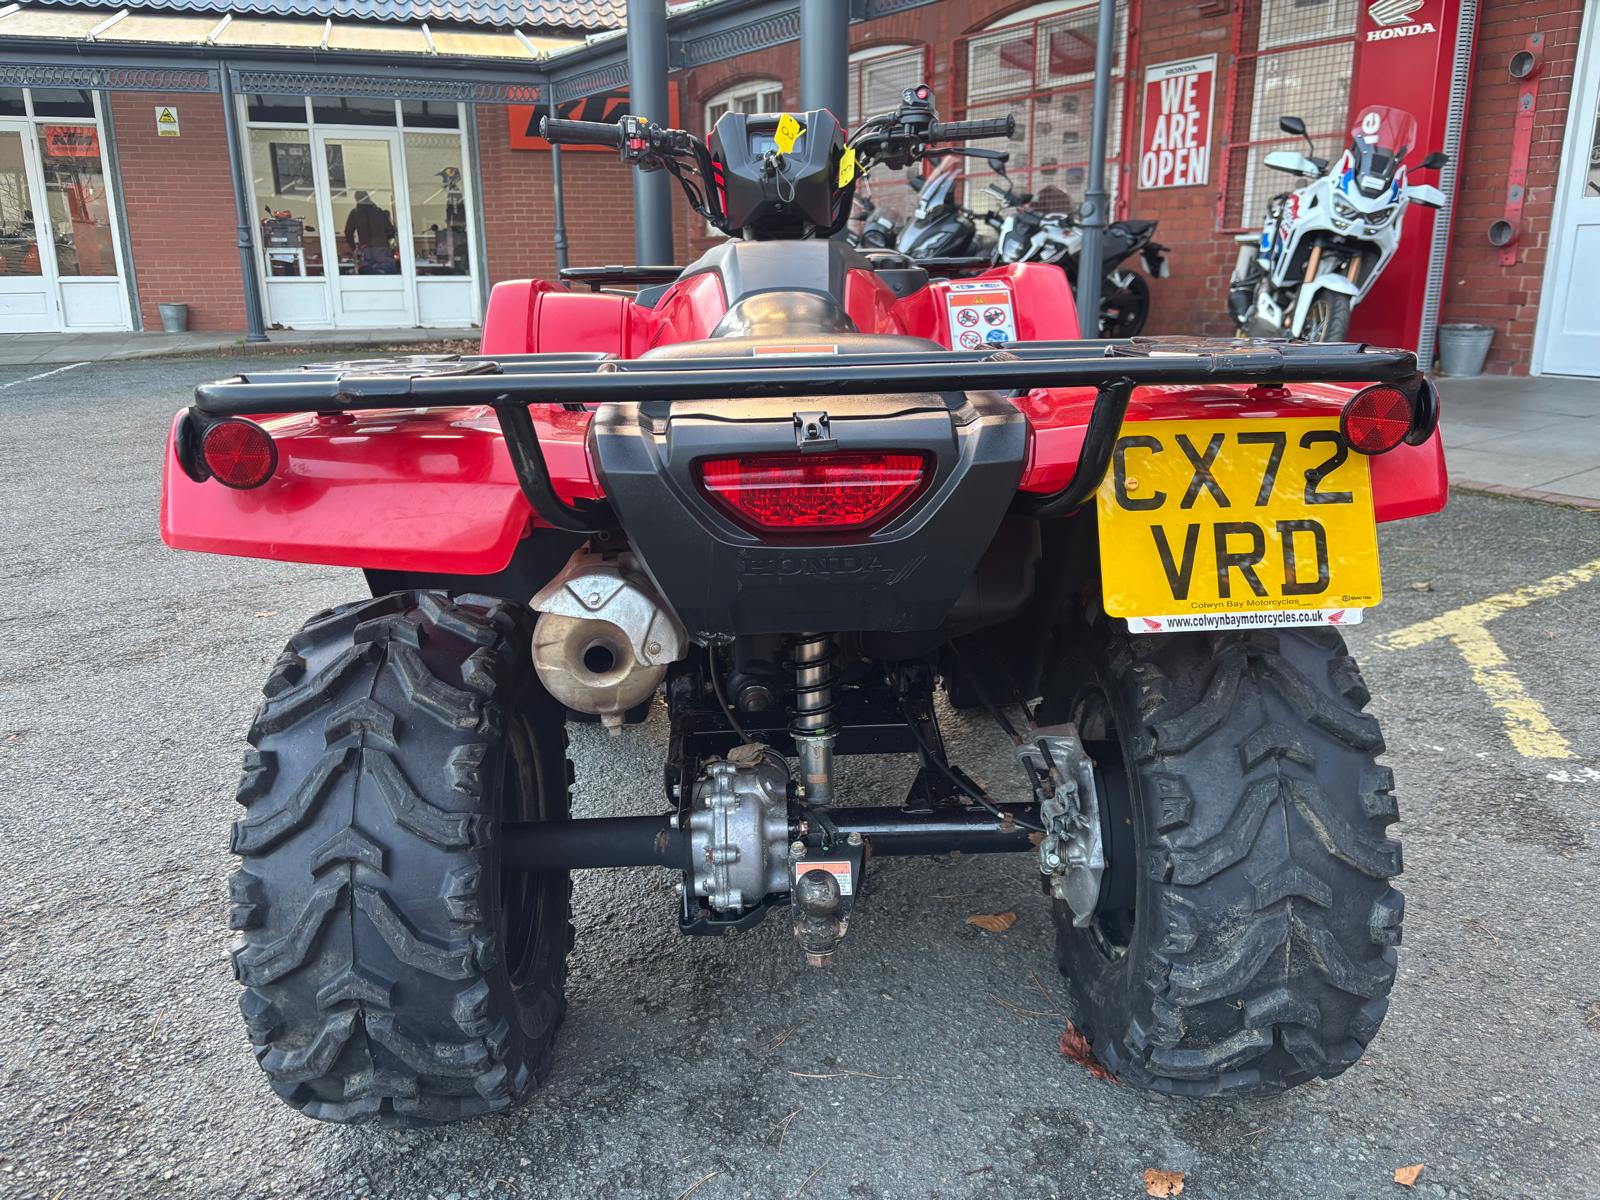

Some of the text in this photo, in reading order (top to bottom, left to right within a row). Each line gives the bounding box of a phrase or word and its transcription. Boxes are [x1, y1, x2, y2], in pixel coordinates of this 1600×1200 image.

[1366, 23, 1437, 41] HONDA
[1161, 74, 1199, 115] WE
[1151, 111, 1200, 152] ARE
[1142, 146, 1205, 189] OPEN
[1113, 429, 1354, 511] CX72
[1150, 518, 1331, 601] VRD
[1167, 610, 1324, 629] www.colwynbaymotorcycles.co.uk
[1190, 601, 1224, 610] Colwyn
[1226, 600, 1244, 609] Bay
[1246, 598, 1300, 607] Motorcycles
